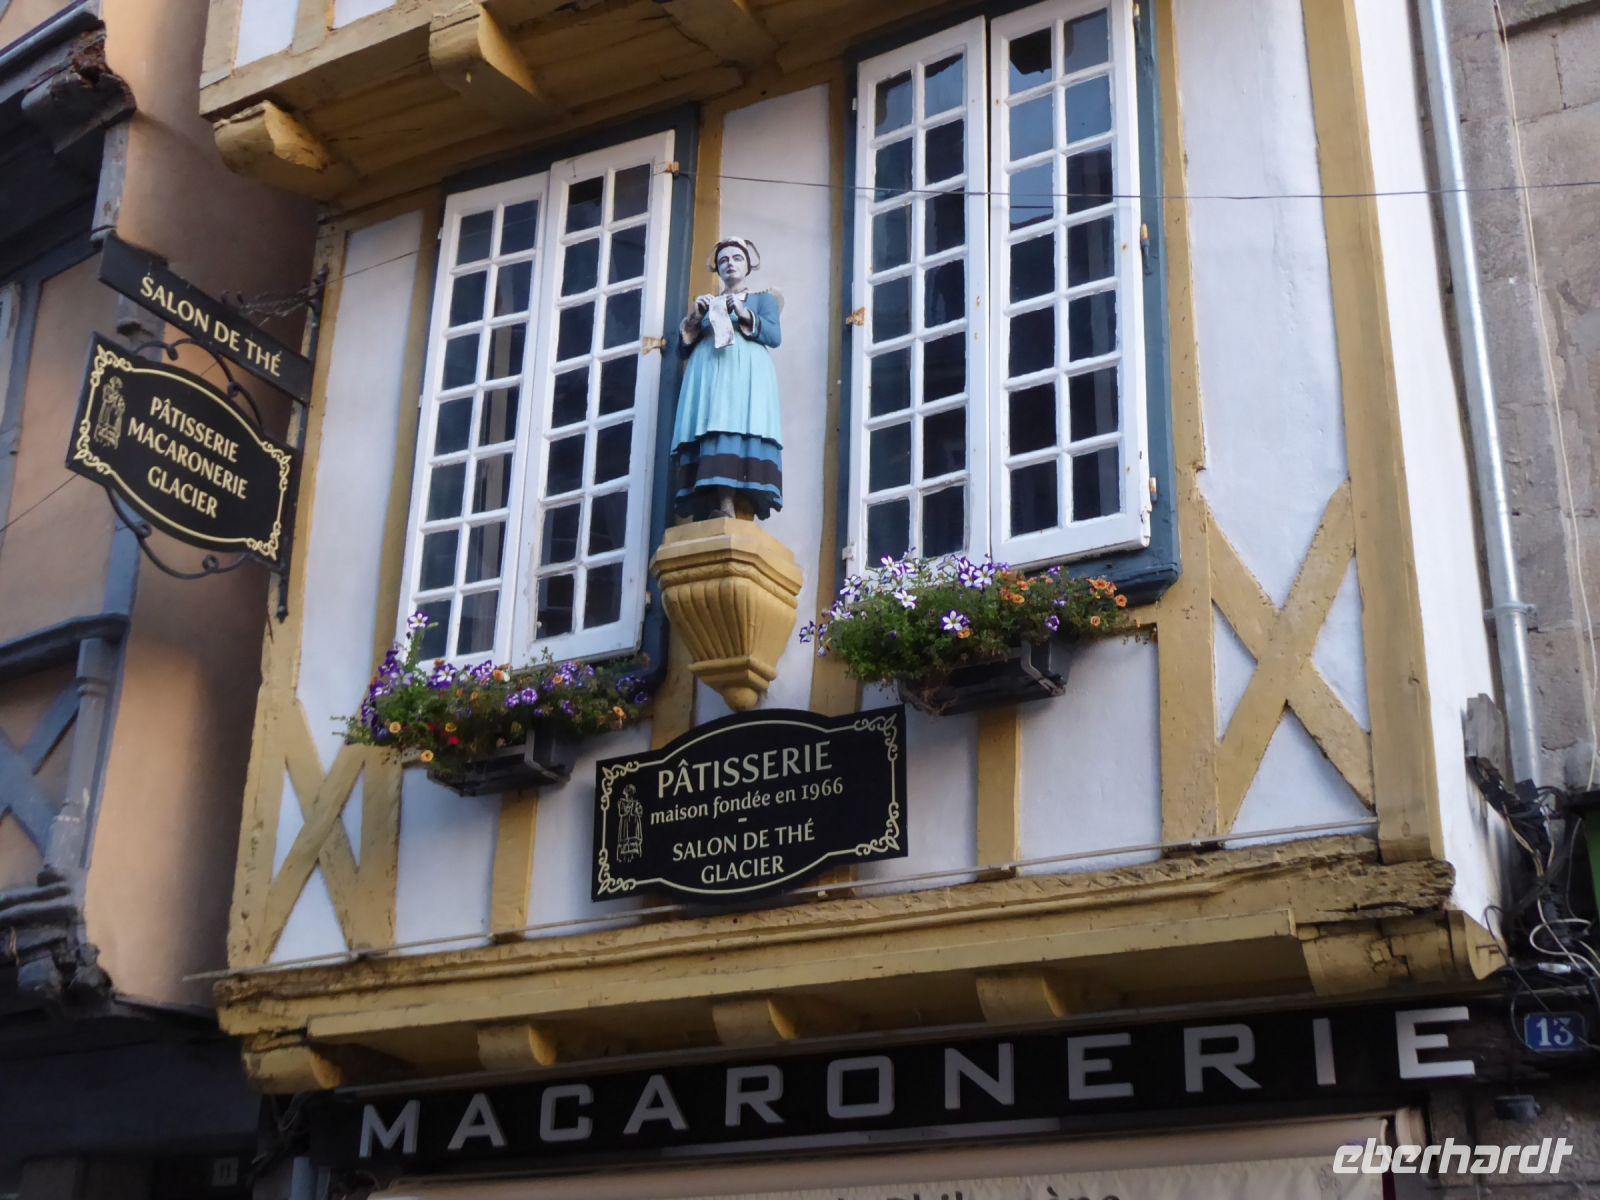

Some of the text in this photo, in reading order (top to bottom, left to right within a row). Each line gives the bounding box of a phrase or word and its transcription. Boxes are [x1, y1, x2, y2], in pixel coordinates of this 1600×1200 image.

[140, 276, 282, 378] SALON DE THÉ
[151, 396, 239, 462] PÂTISSERIE
[128, 417, 248, 499] MACARONERIE
[148, 465, 218, 518] GLACIER
[657, 741, 832, 798] PÂTISSERIE
[650, 777, 843, 825] maison fondée en 1966
[672, 819, 816, 861] SALON DE THÉ
[702, 856, 785, 884] GLACIER
[1537, 1017, 1574, 1048] 13
[358, 1006, 1475, 1159] MACARONERIE
